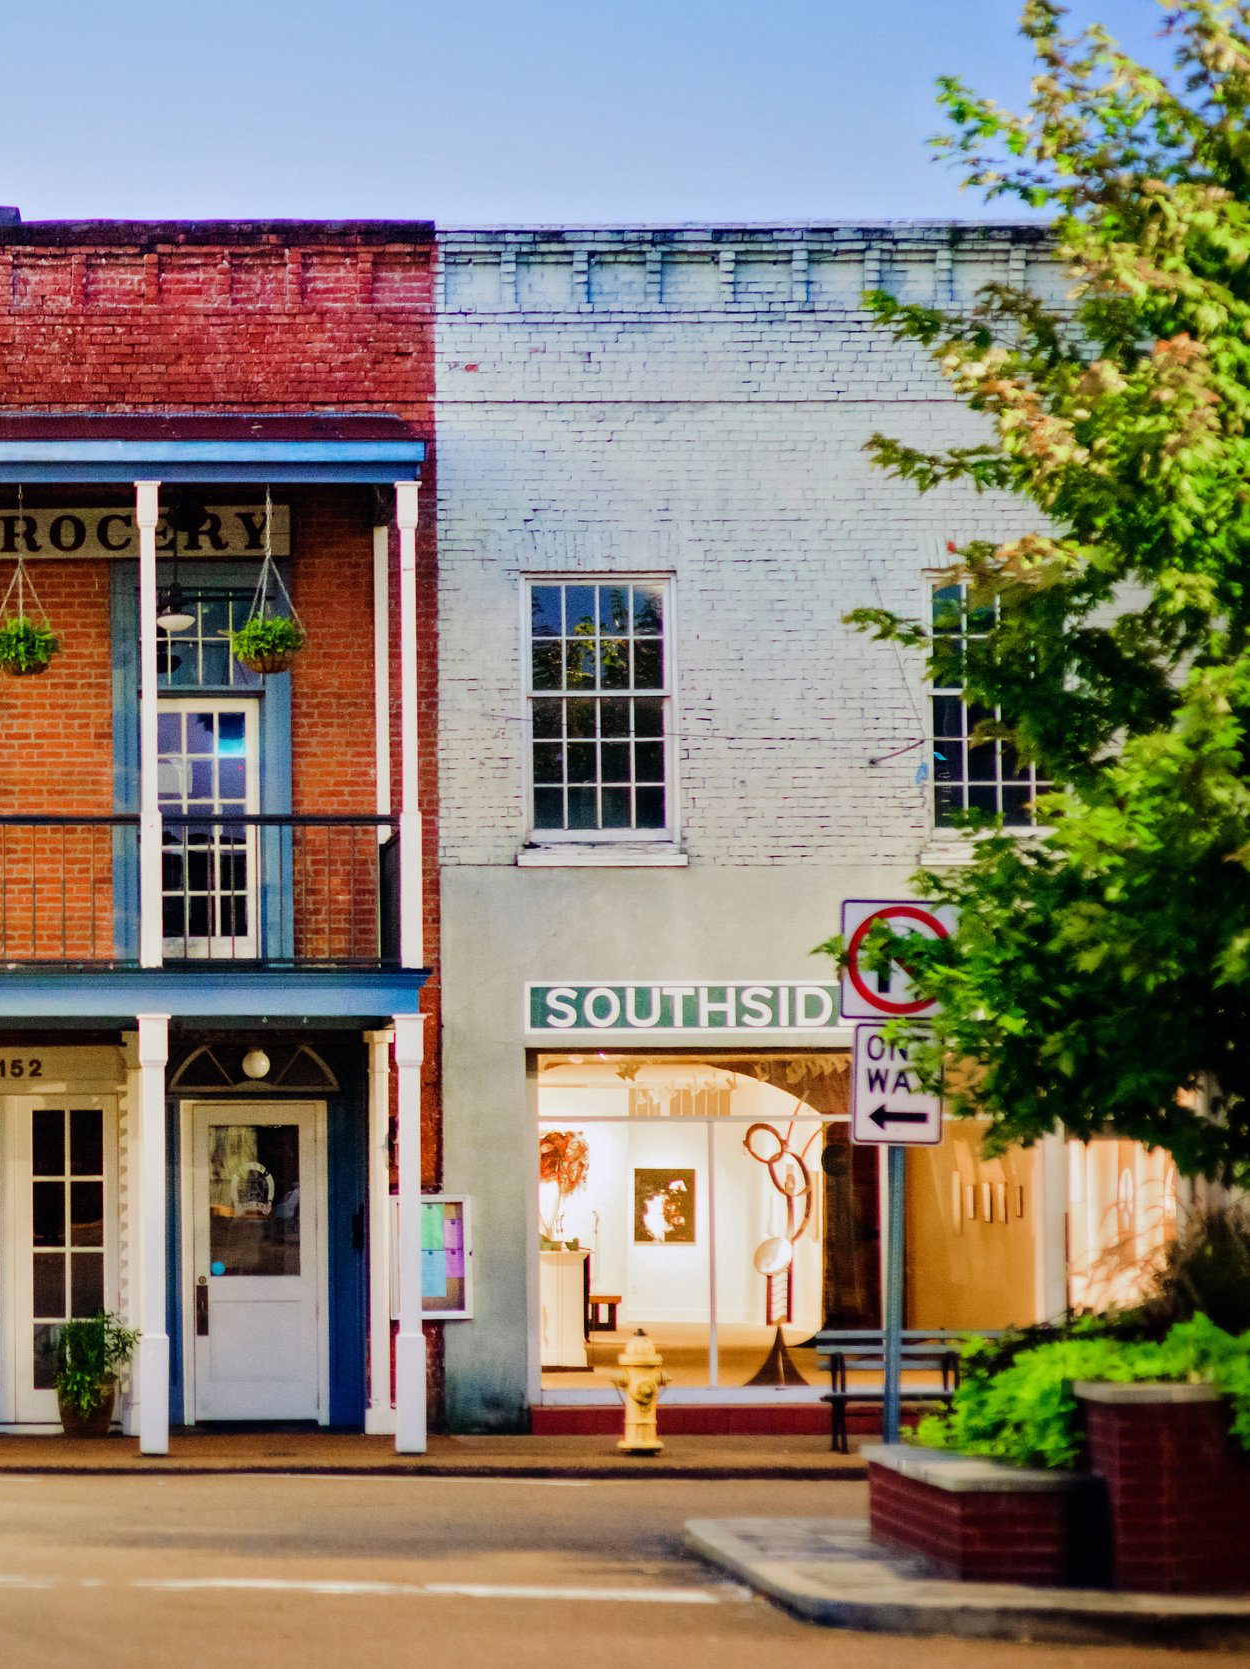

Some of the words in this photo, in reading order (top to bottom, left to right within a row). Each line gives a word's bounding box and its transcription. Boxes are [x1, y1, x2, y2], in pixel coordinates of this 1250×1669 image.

[546, 986, 854, 1028] SOUTHSID
[867, 1034, 933, 1061] ON
[867, 1068, 932, 1094] WA
